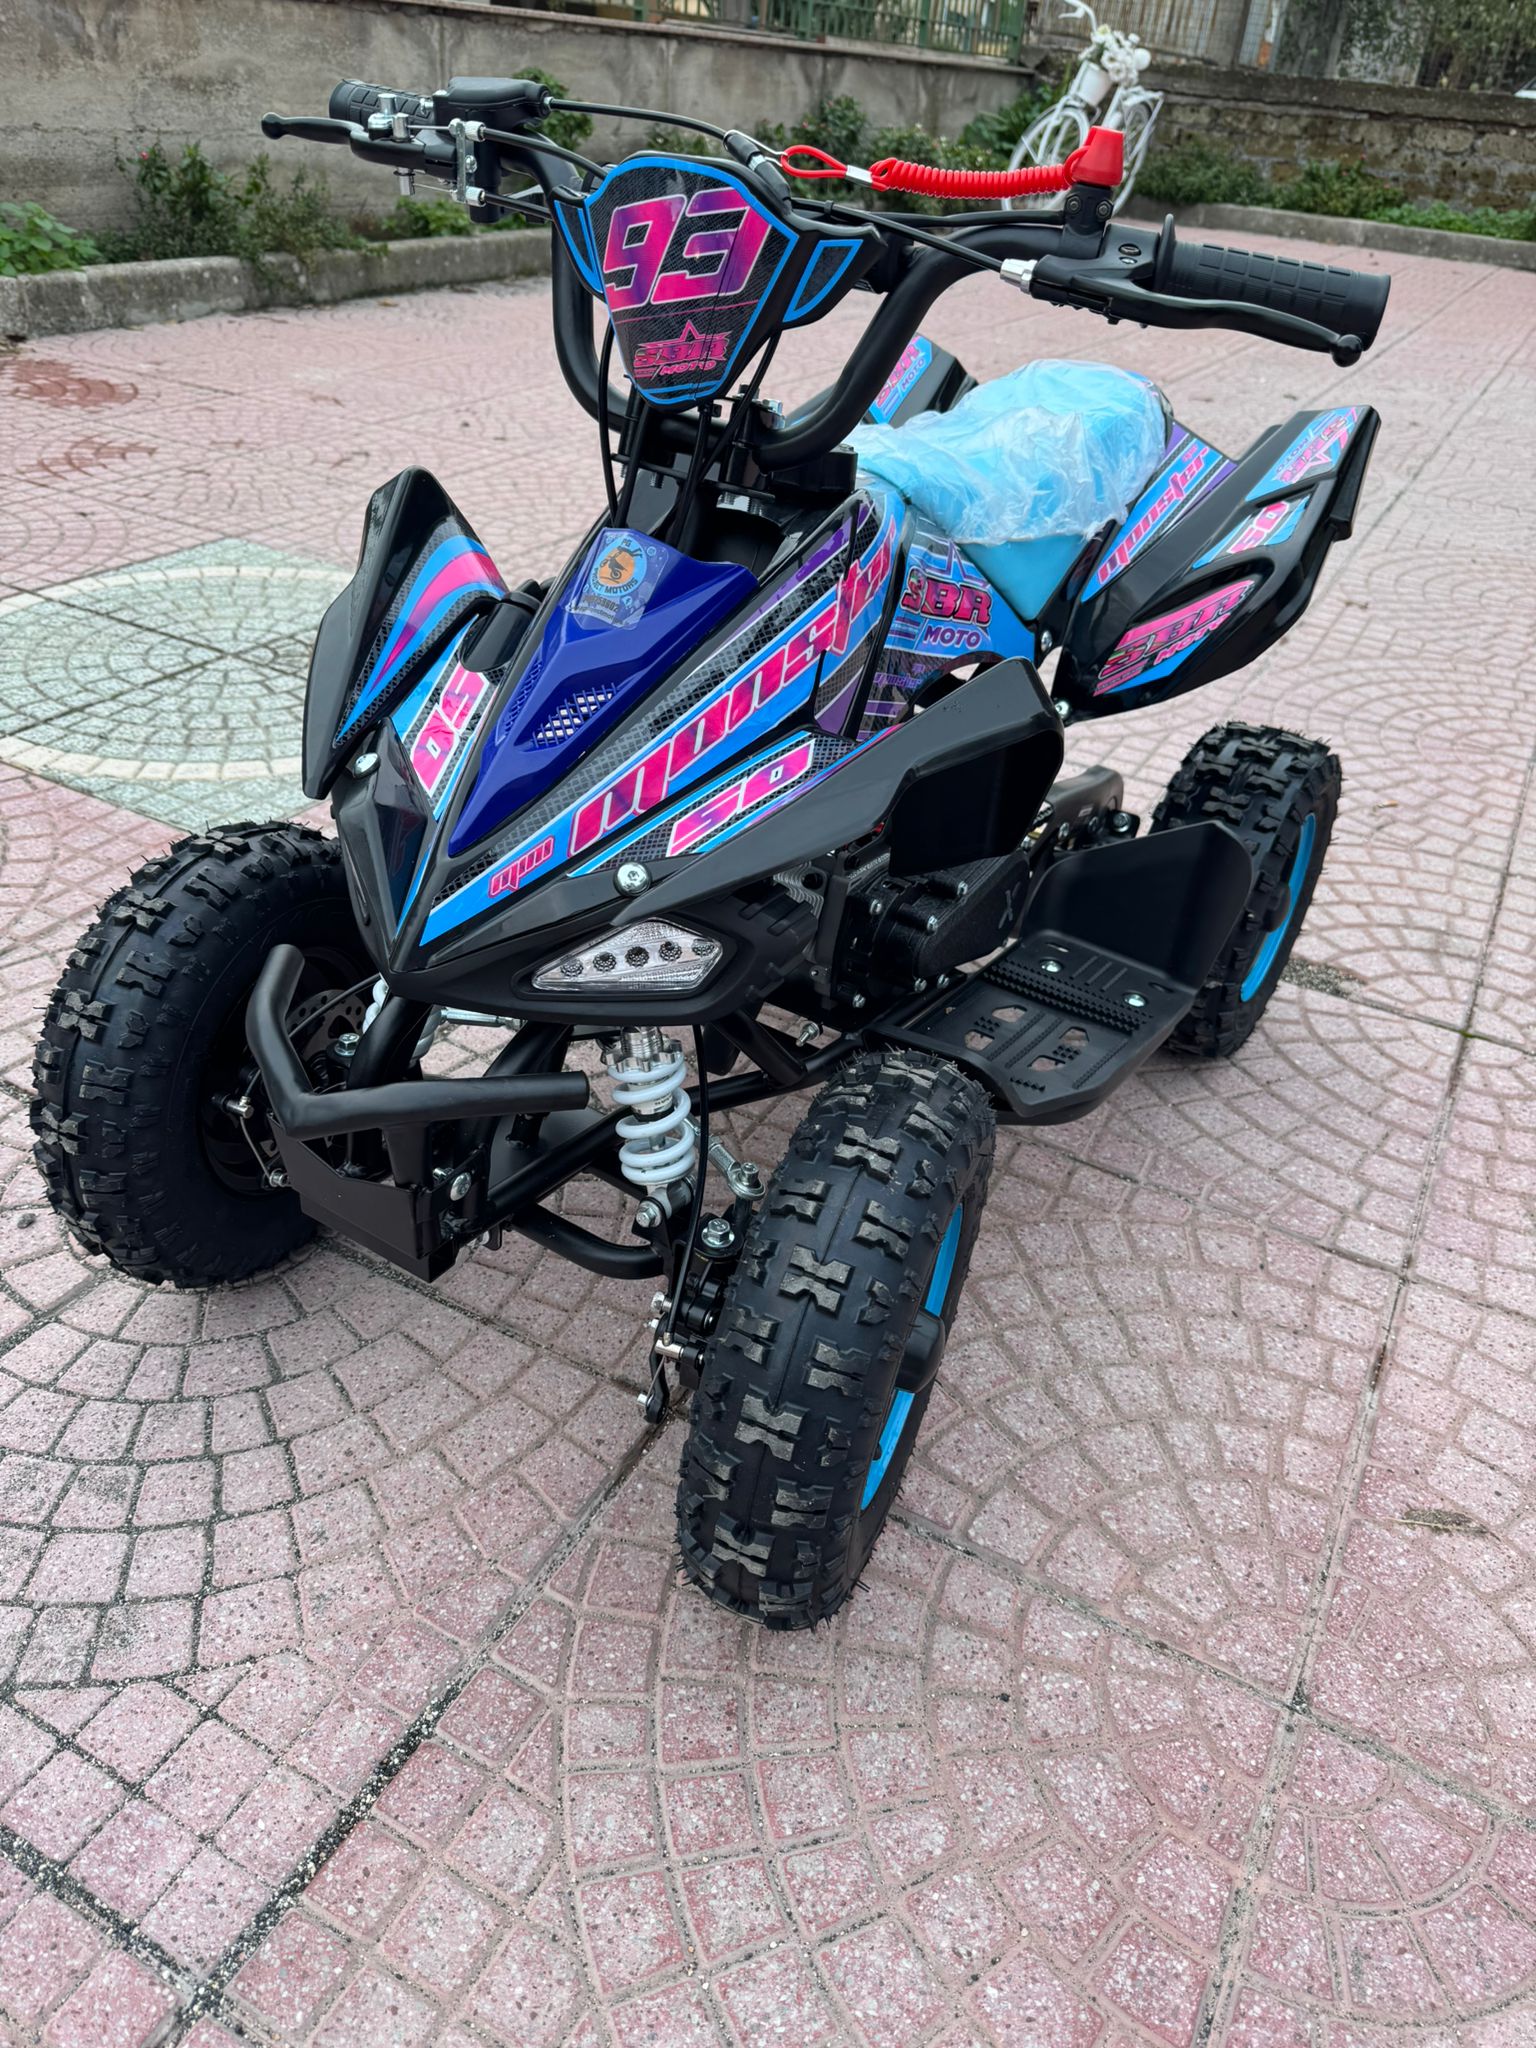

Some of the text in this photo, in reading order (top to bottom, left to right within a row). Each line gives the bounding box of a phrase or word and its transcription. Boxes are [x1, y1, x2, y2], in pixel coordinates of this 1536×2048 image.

[603, 187, 773, 312] 93
[659, 360, 717, 376] MOTO
[900, 358, 926, 393] MOTO
[1227, 500, 1290, 554] 50
[604, 578, 639, 594] MOTORS
[900, 567, 993, 627] SBR
[921, 624, 982, 649] MOTO
[1098, 584, 1253, 680] SBR
[410, 660, 490, 798] 50
[666, 738, 817, 858] 50
